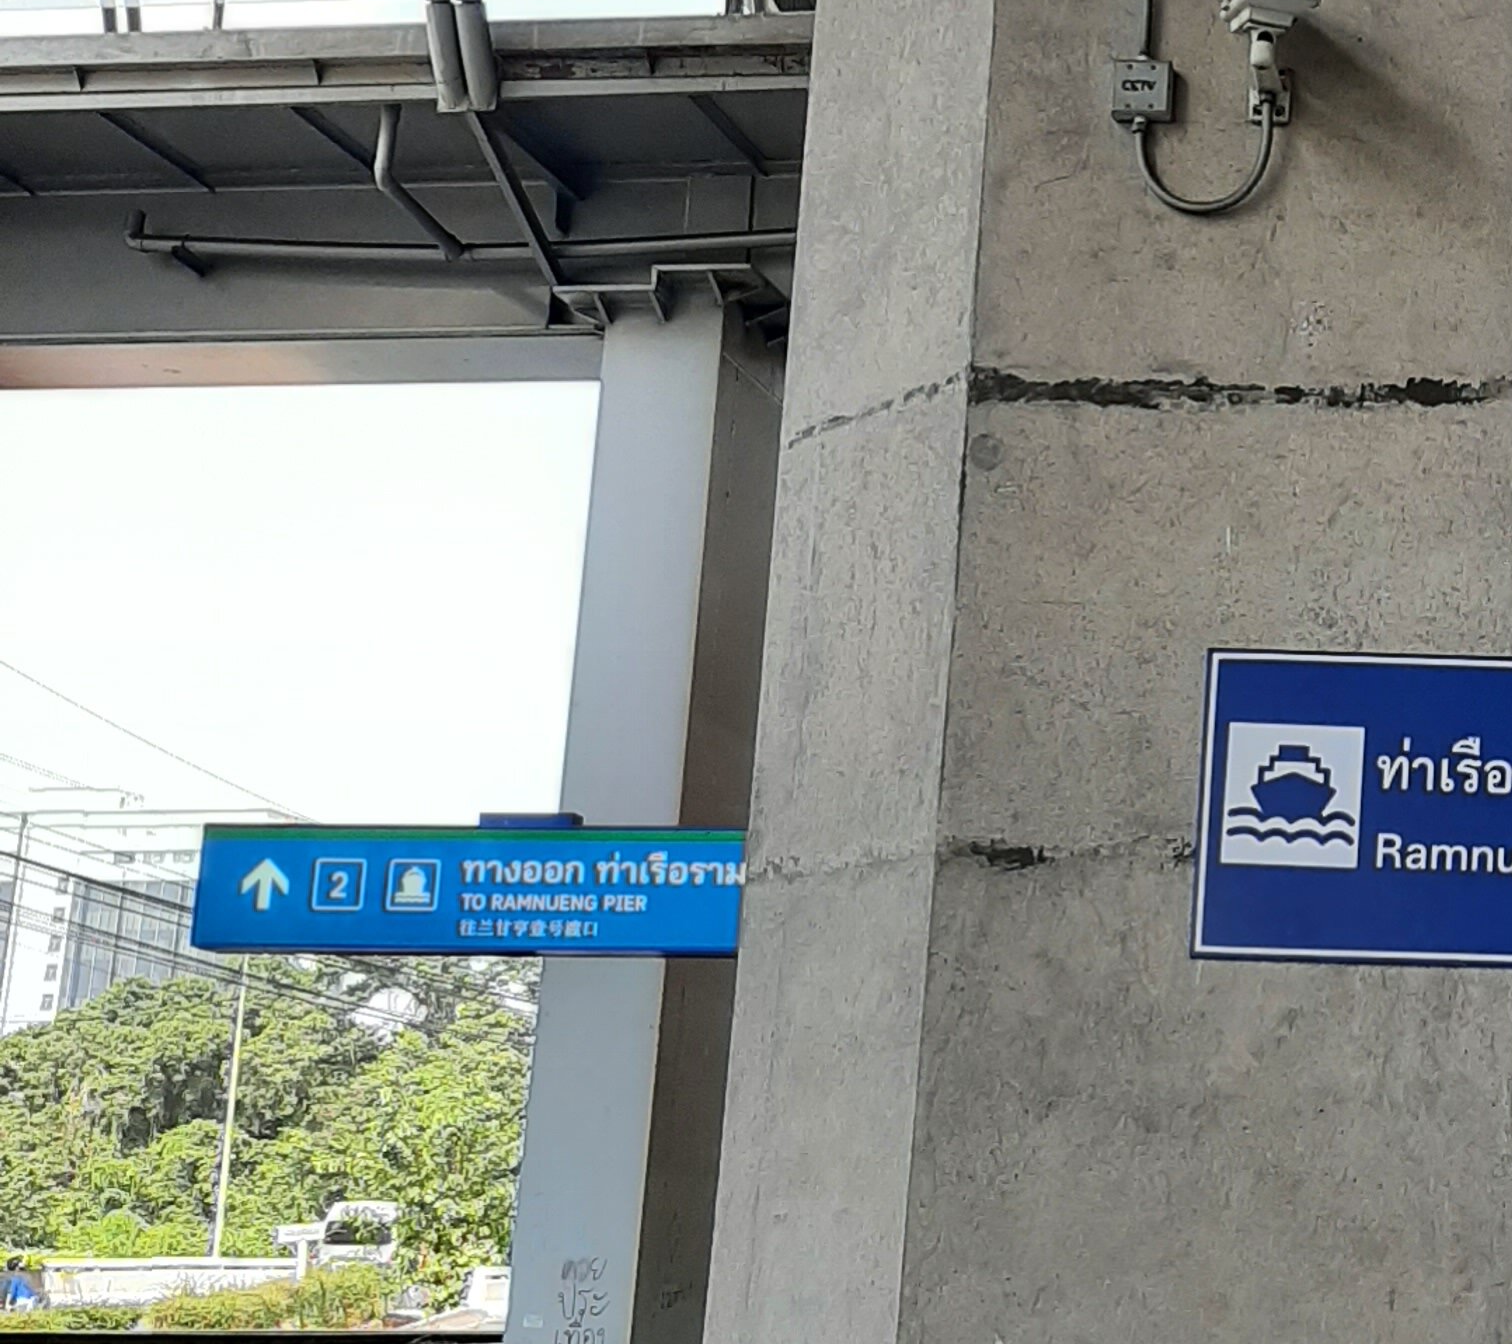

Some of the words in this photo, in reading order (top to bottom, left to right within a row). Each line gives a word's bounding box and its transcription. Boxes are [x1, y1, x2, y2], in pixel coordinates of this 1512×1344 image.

[1121, 79, 1157, 92] CCTV
[462, 859, 584, 884] ทางออก
[330, 871, 348, 898] 2
[461, 893, 486, 911] TO
[491, 894, 598, 912] RAMNUENG
[603, 895, 648, 912] PIER
